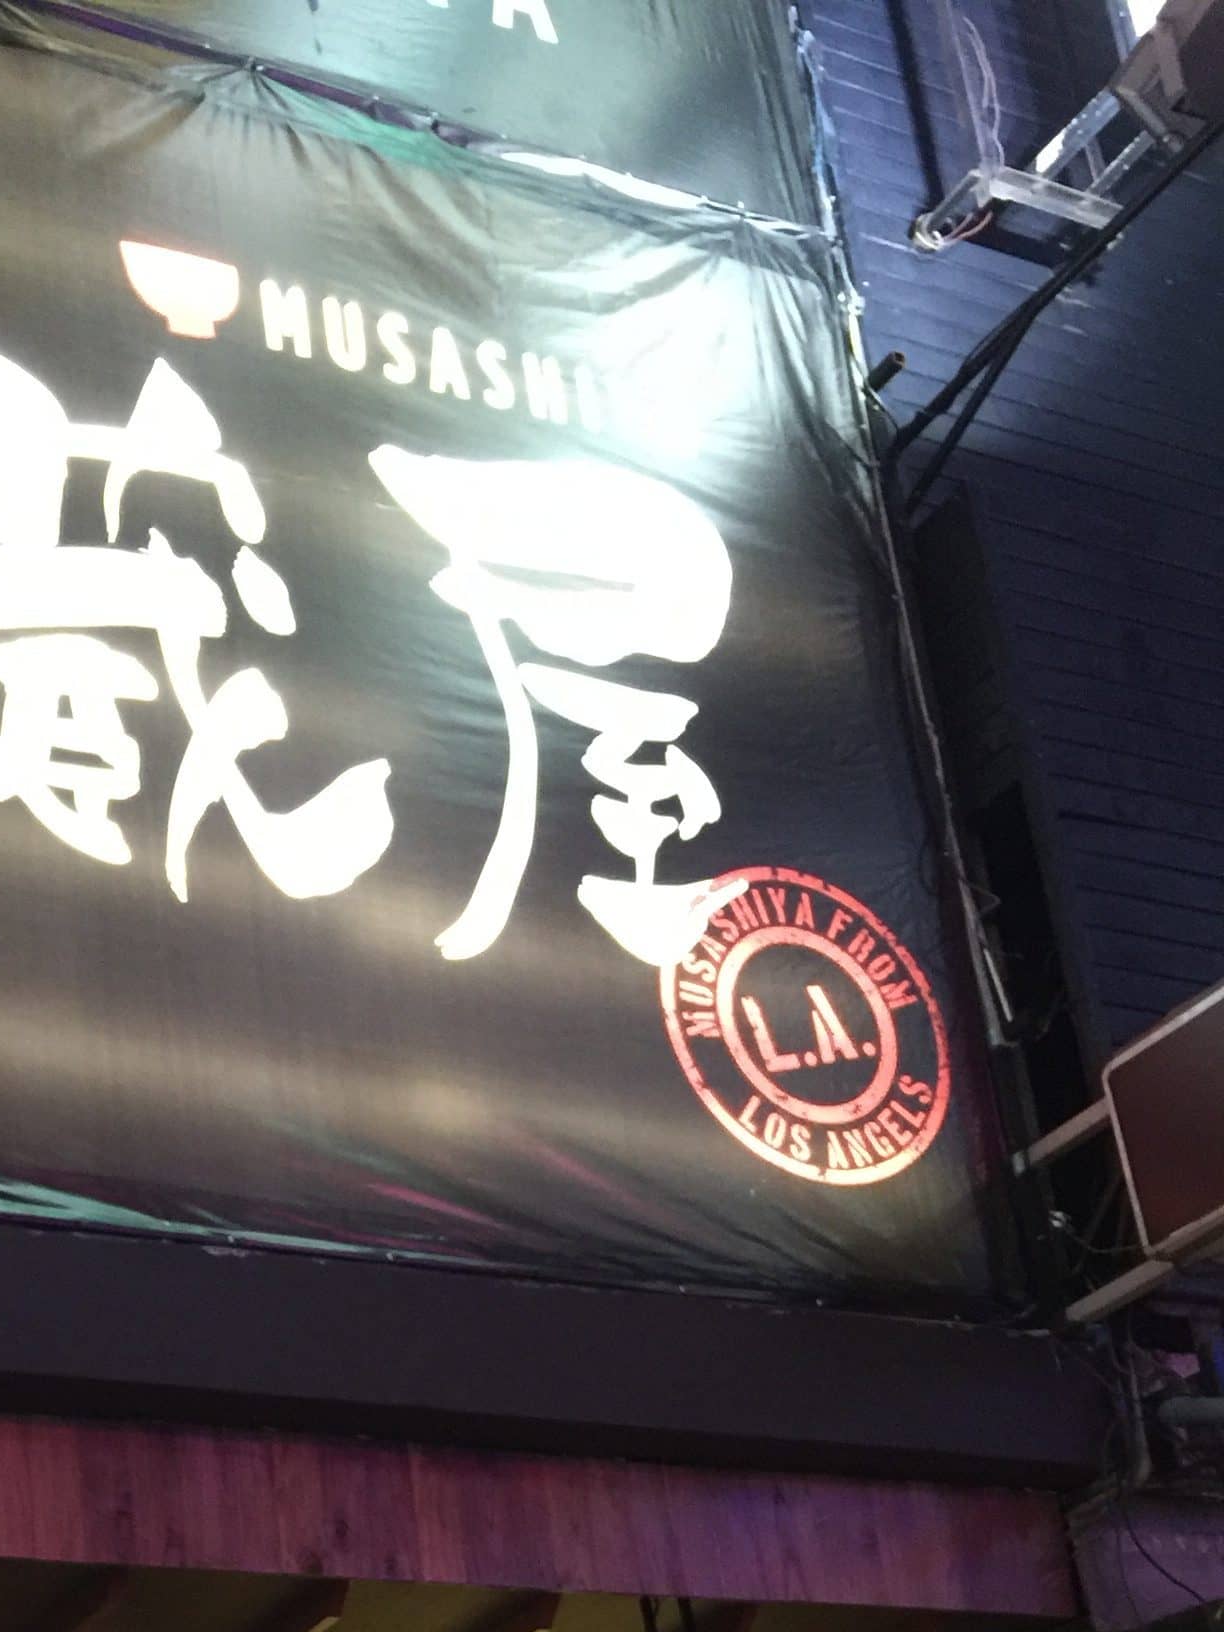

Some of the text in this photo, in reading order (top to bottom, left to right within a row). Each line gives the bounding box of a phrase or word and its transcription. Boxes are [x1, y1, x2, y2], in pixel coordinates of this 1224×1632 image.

[678, 886, 918, 1038] MUSASHIYA FROM
[740, 984, 877, 1073] L.A.
[737, 1074, 933, 1169] LOS ANGELS
